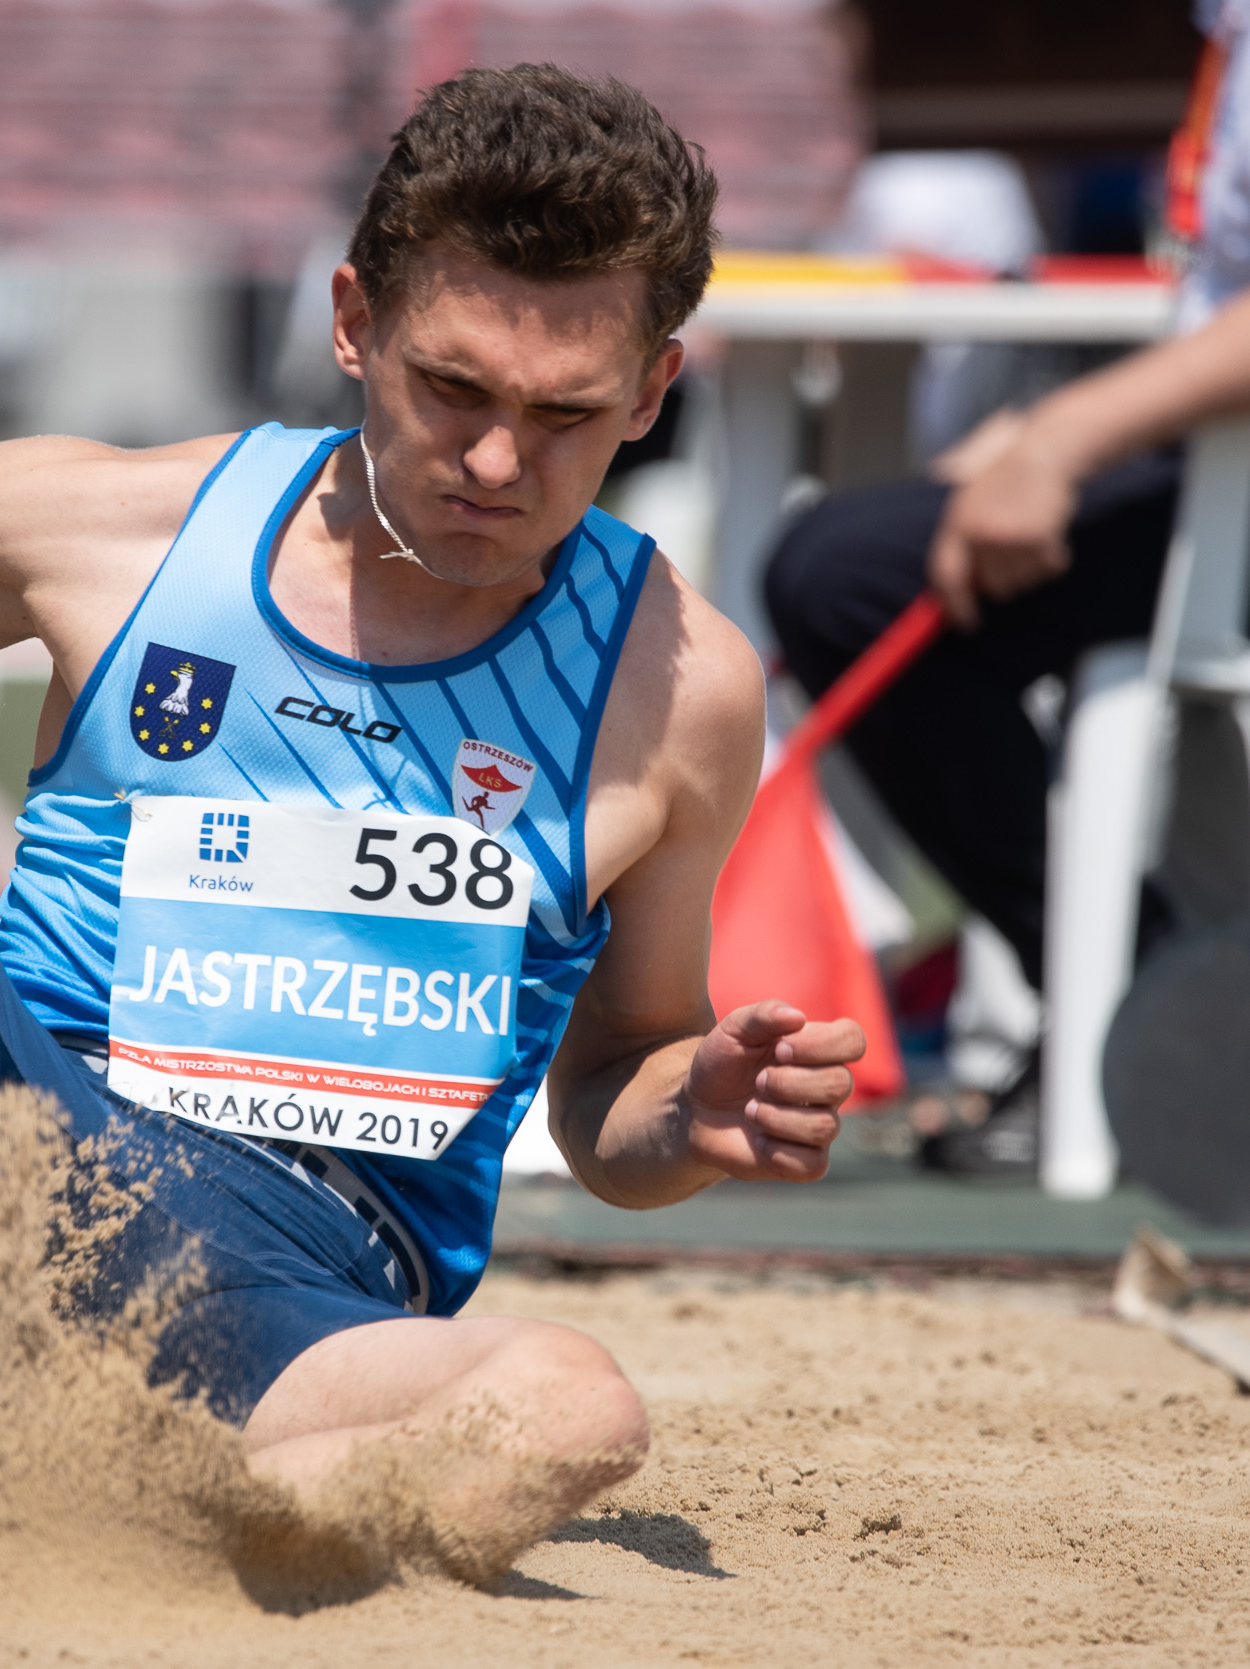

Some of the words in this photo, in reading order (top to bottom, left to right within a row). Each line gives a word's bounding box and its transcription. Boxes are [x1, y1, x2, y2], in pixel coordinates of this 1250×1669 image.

[274, 696, 403, 744] COLO
[463, 741, 534, 772] OSTRZESZÓW
[478, 772, 502, 788] LKS
[189, 874, 254, 893] Kraków
[350, 827, 514, 910] 538
[127, 945, 512, 1037] JASTRZĘBSKI
[118, 1047, 151, 1065] PZLA
[153, 1058, 253, 1076] MISTRZOSTWA
[255, 1067, 304, 1082] POLSKI
[306, 1073, 320, 1083] W
[323, 1075, 420, 1096] WIELOBOJACH
[168, 1086, 344, 1138] KRAKÓW
[355, 1111, 449, 1151] 2019
